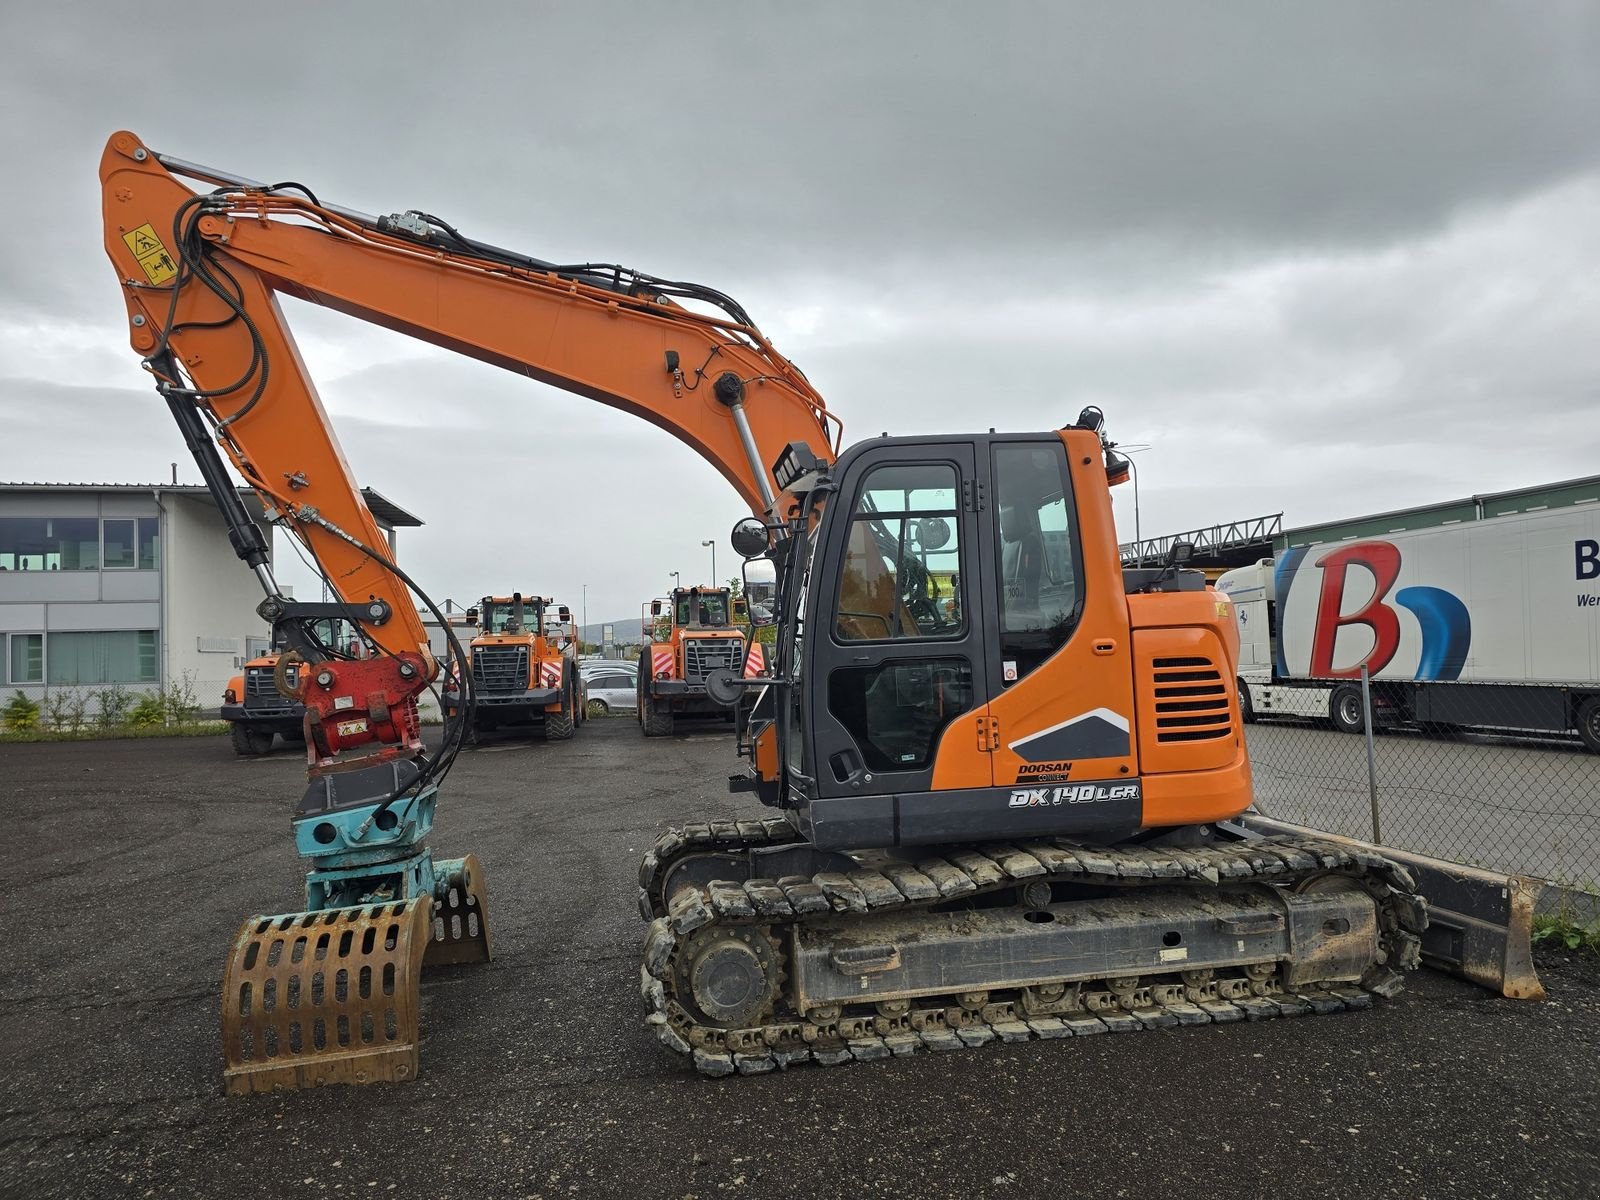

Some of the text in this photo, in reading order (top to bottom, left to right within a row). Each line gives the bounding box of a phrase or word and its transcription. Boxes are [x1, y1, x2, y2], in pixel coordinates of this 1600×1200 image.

[1575, 539, 1600, 580] B
[1309, 540, 1402, 680] B
[1019, 763, 1072, 773] DOOSAN
[1038, 773, 1069, 782] CONNECT
[1008, 788, 1050, 808] DX
